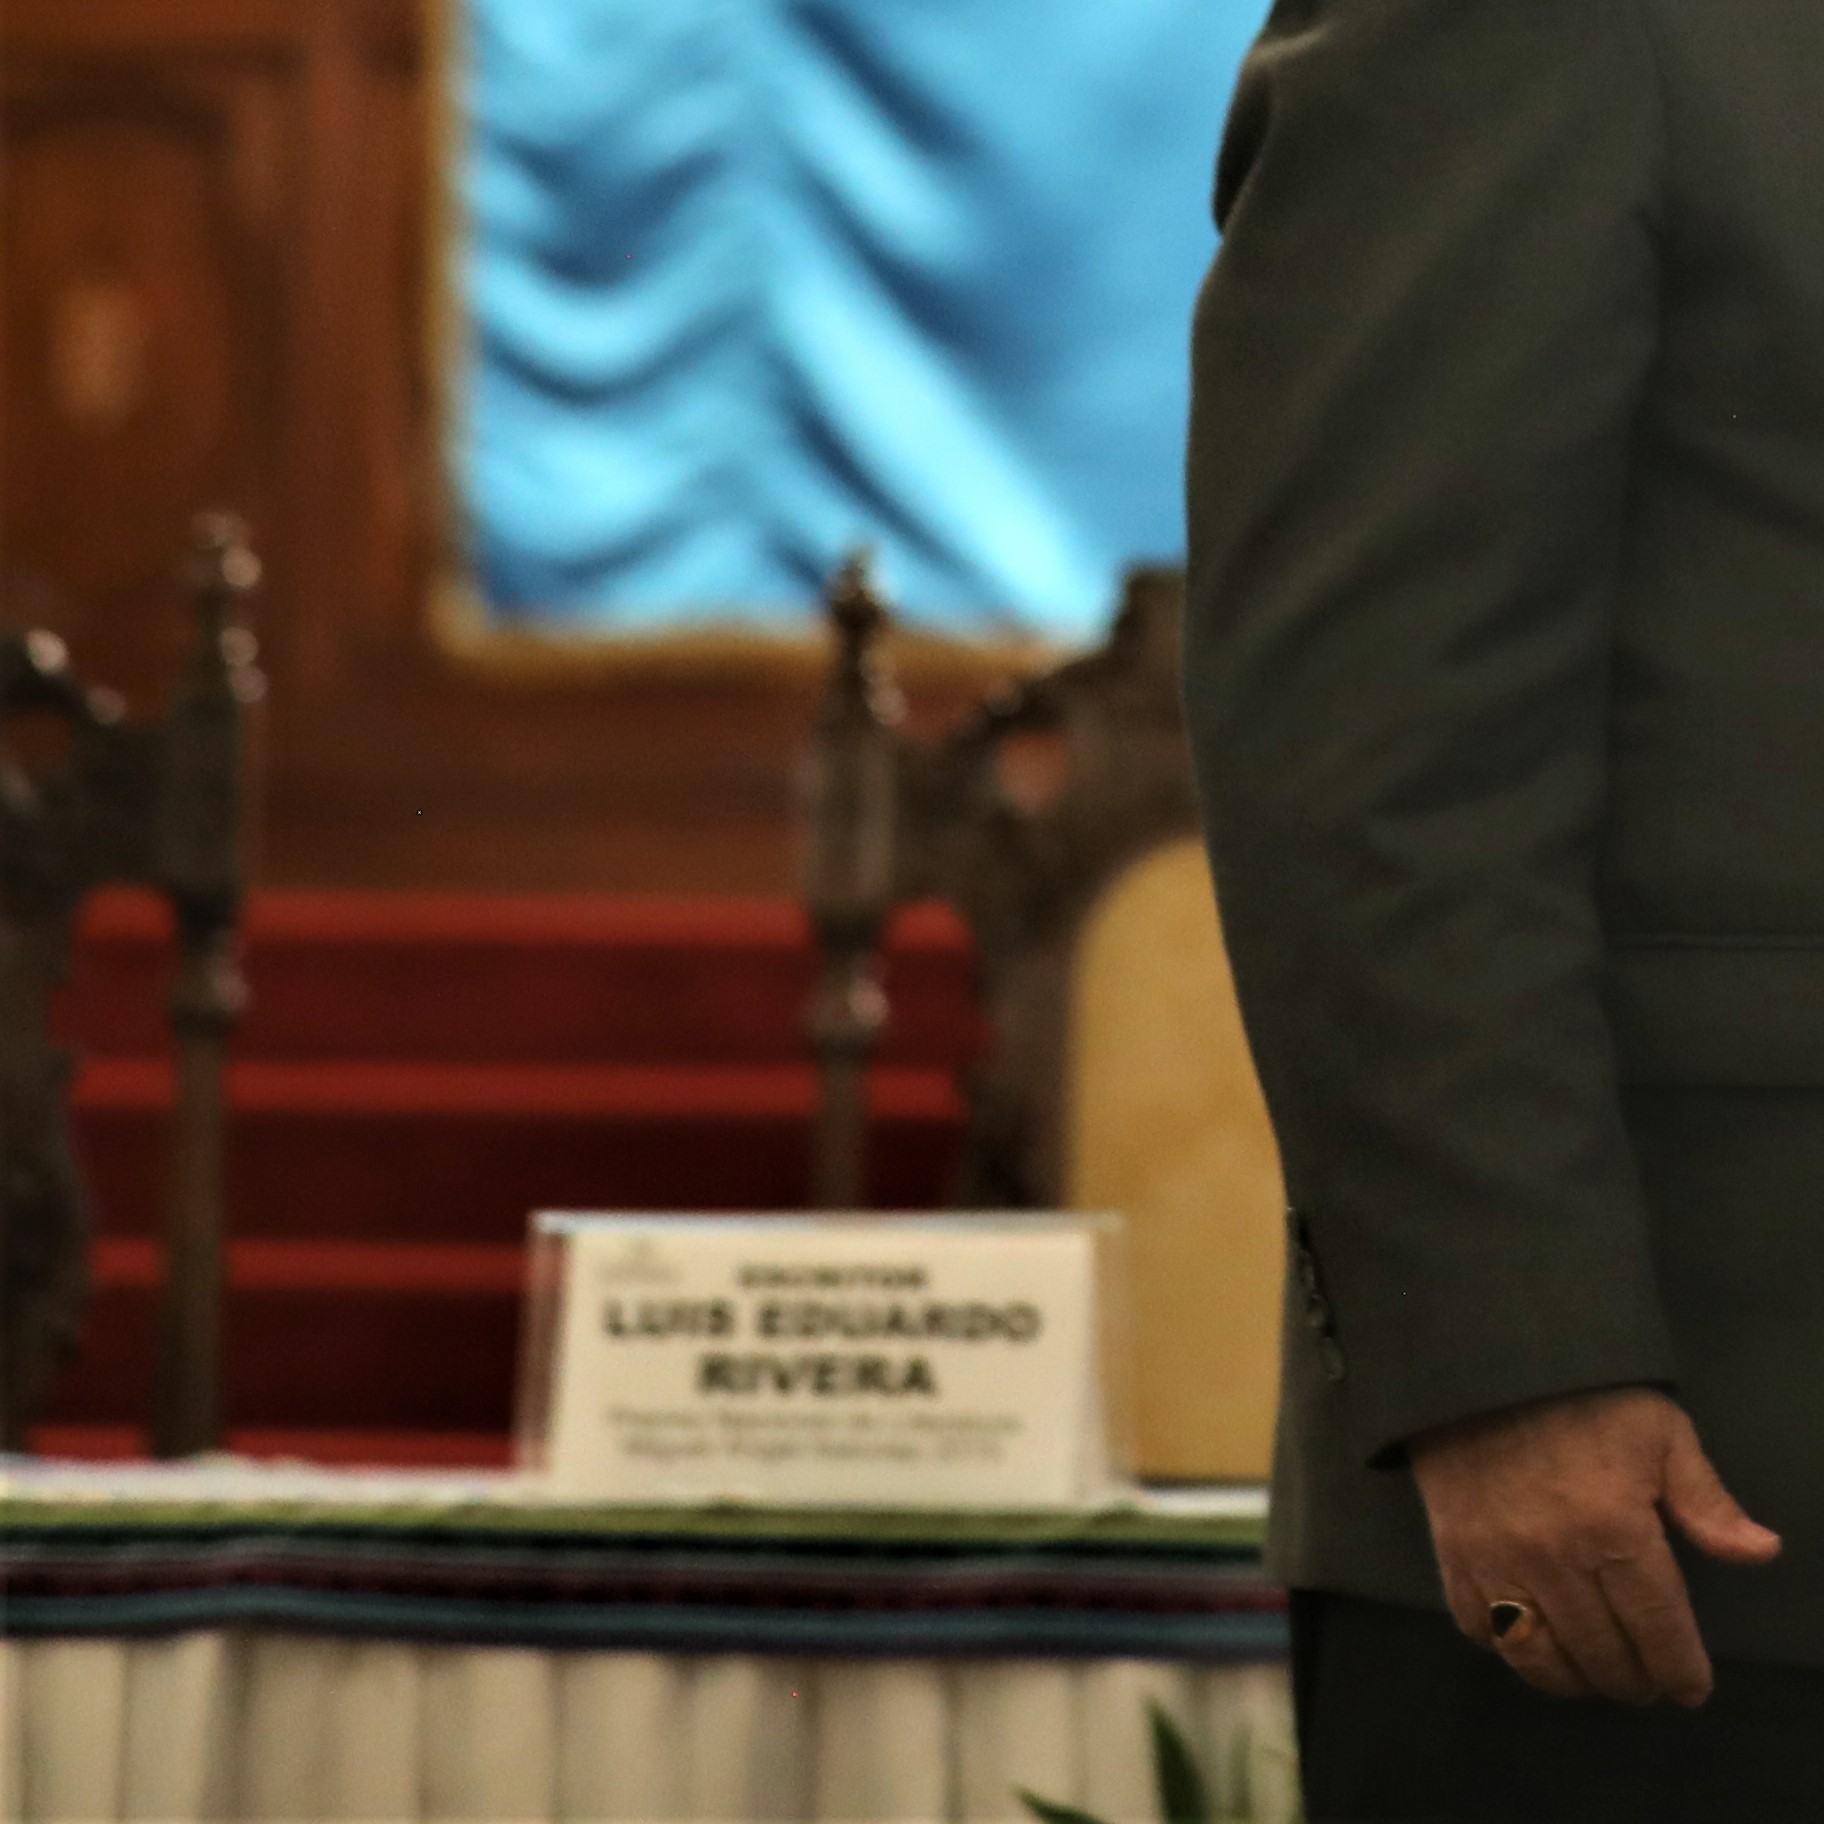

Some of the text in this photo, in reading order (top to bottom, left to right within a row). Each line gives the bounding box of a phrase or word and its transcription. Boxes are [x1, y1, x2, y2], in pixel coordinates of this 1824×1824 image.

[604, 1300, 1042, 1343] LUIS EDUARDO
[697, 1354, 937, 1398] RIVERA
